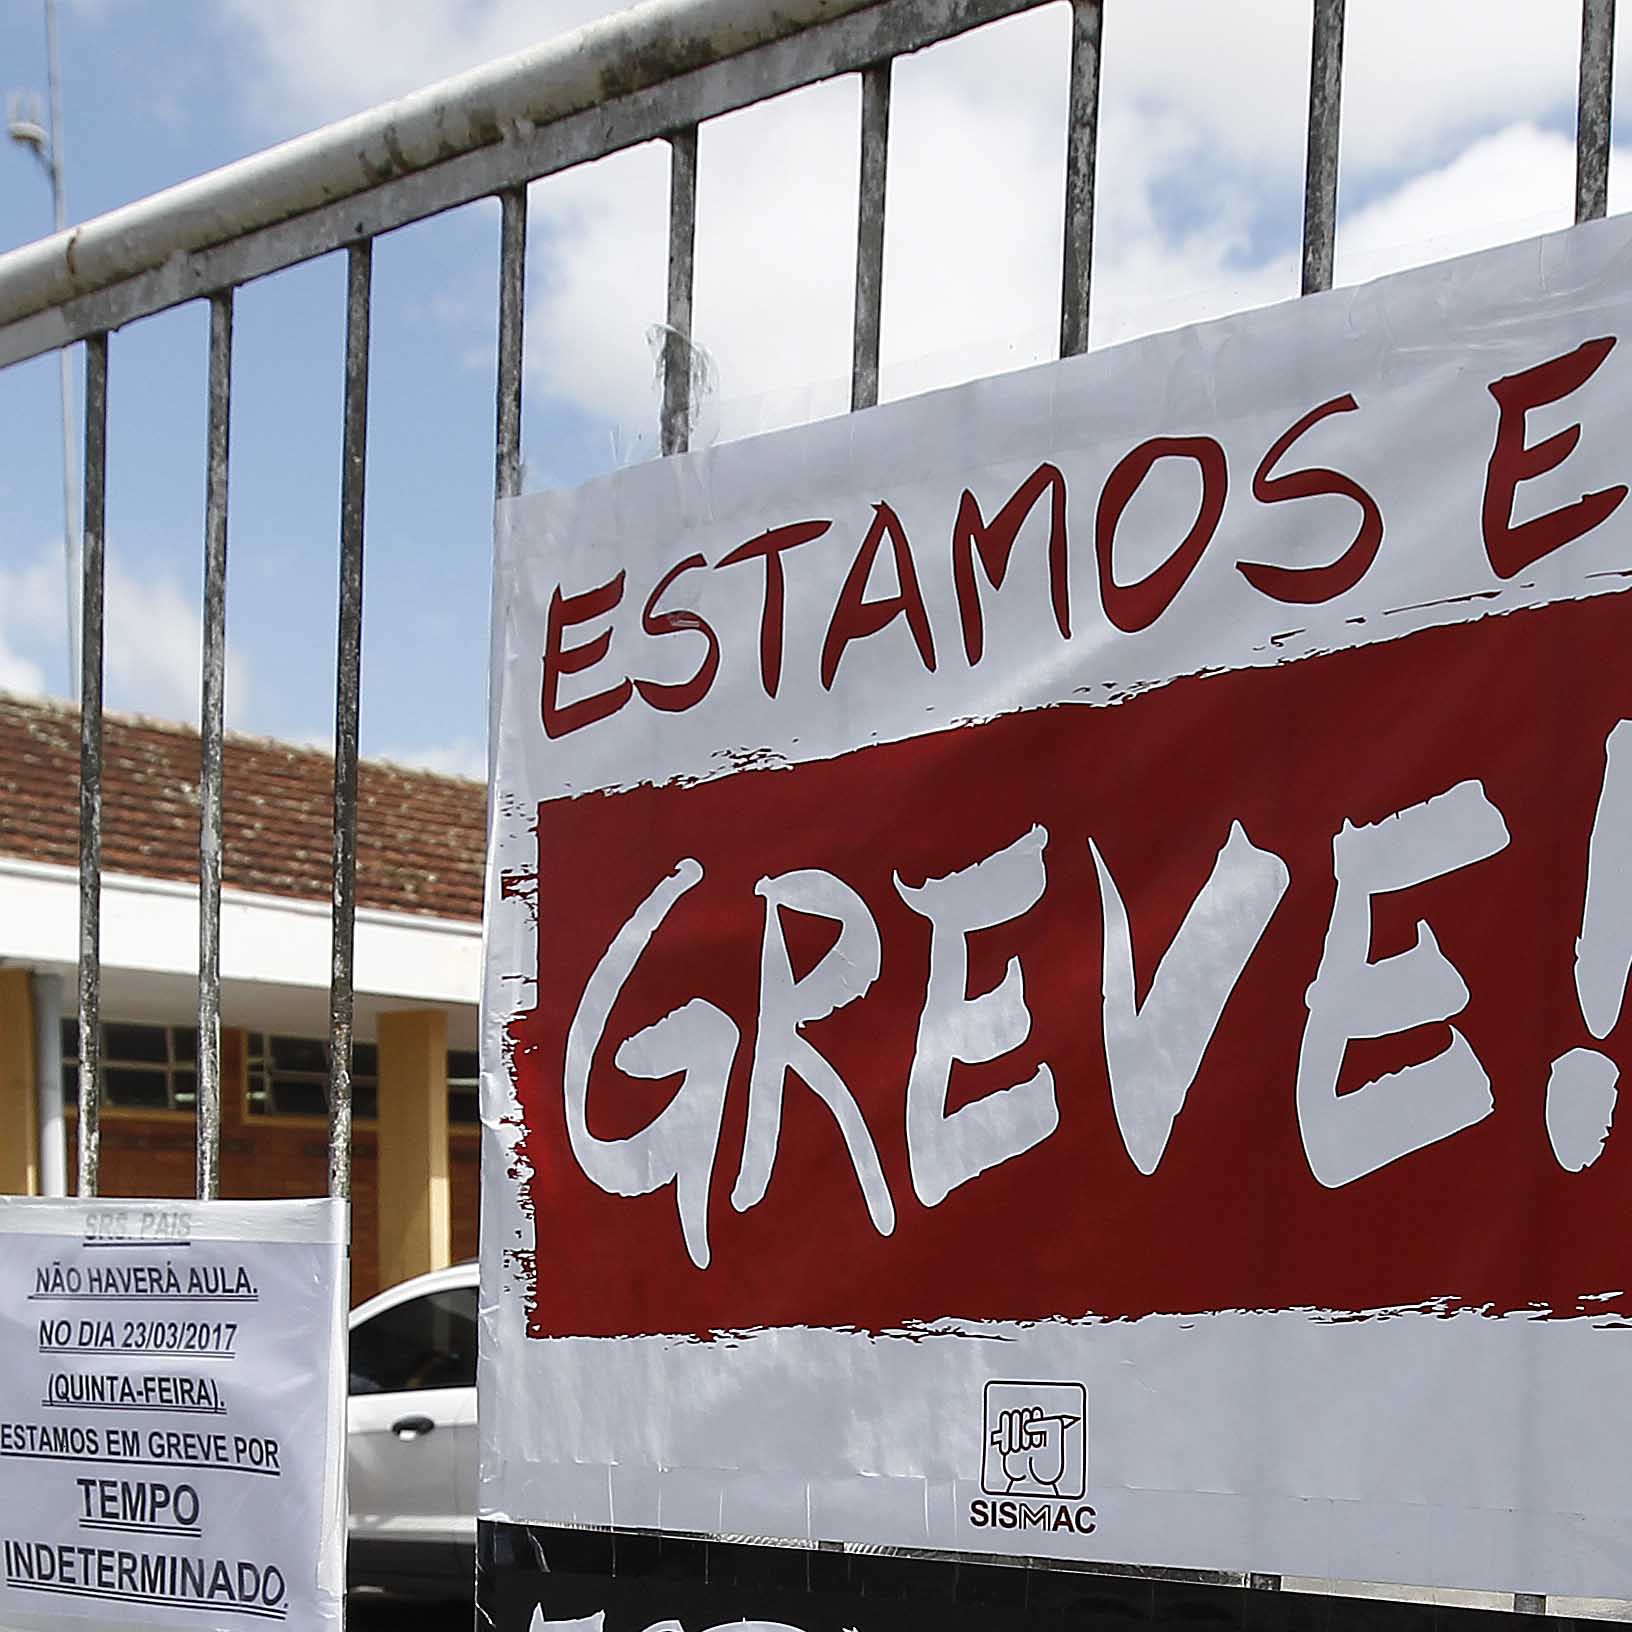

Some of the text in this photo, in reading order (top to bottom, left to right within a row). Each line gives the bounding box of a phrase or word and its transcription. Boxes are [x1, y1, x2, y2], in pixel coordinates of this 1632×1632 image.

[539, 393, 1383, 740] ESTAMOS
[36, 1261, 258, 1295] NÃO HAVERÁ AULA.
[39, 1320, 237, 1351] NO DIA 23/03/2017
[47, 1373, 225, 1413] (QUINTA-FEIRA).
[0, 1423, 280, 1469] ESTAMOS EM GREVE POR
[76, 1478, 200, 1525] TEMPO
[970, 1500, 1096, 1534] SISMAC
[4, 1540, 288, 1610] INDETERMINADO.
